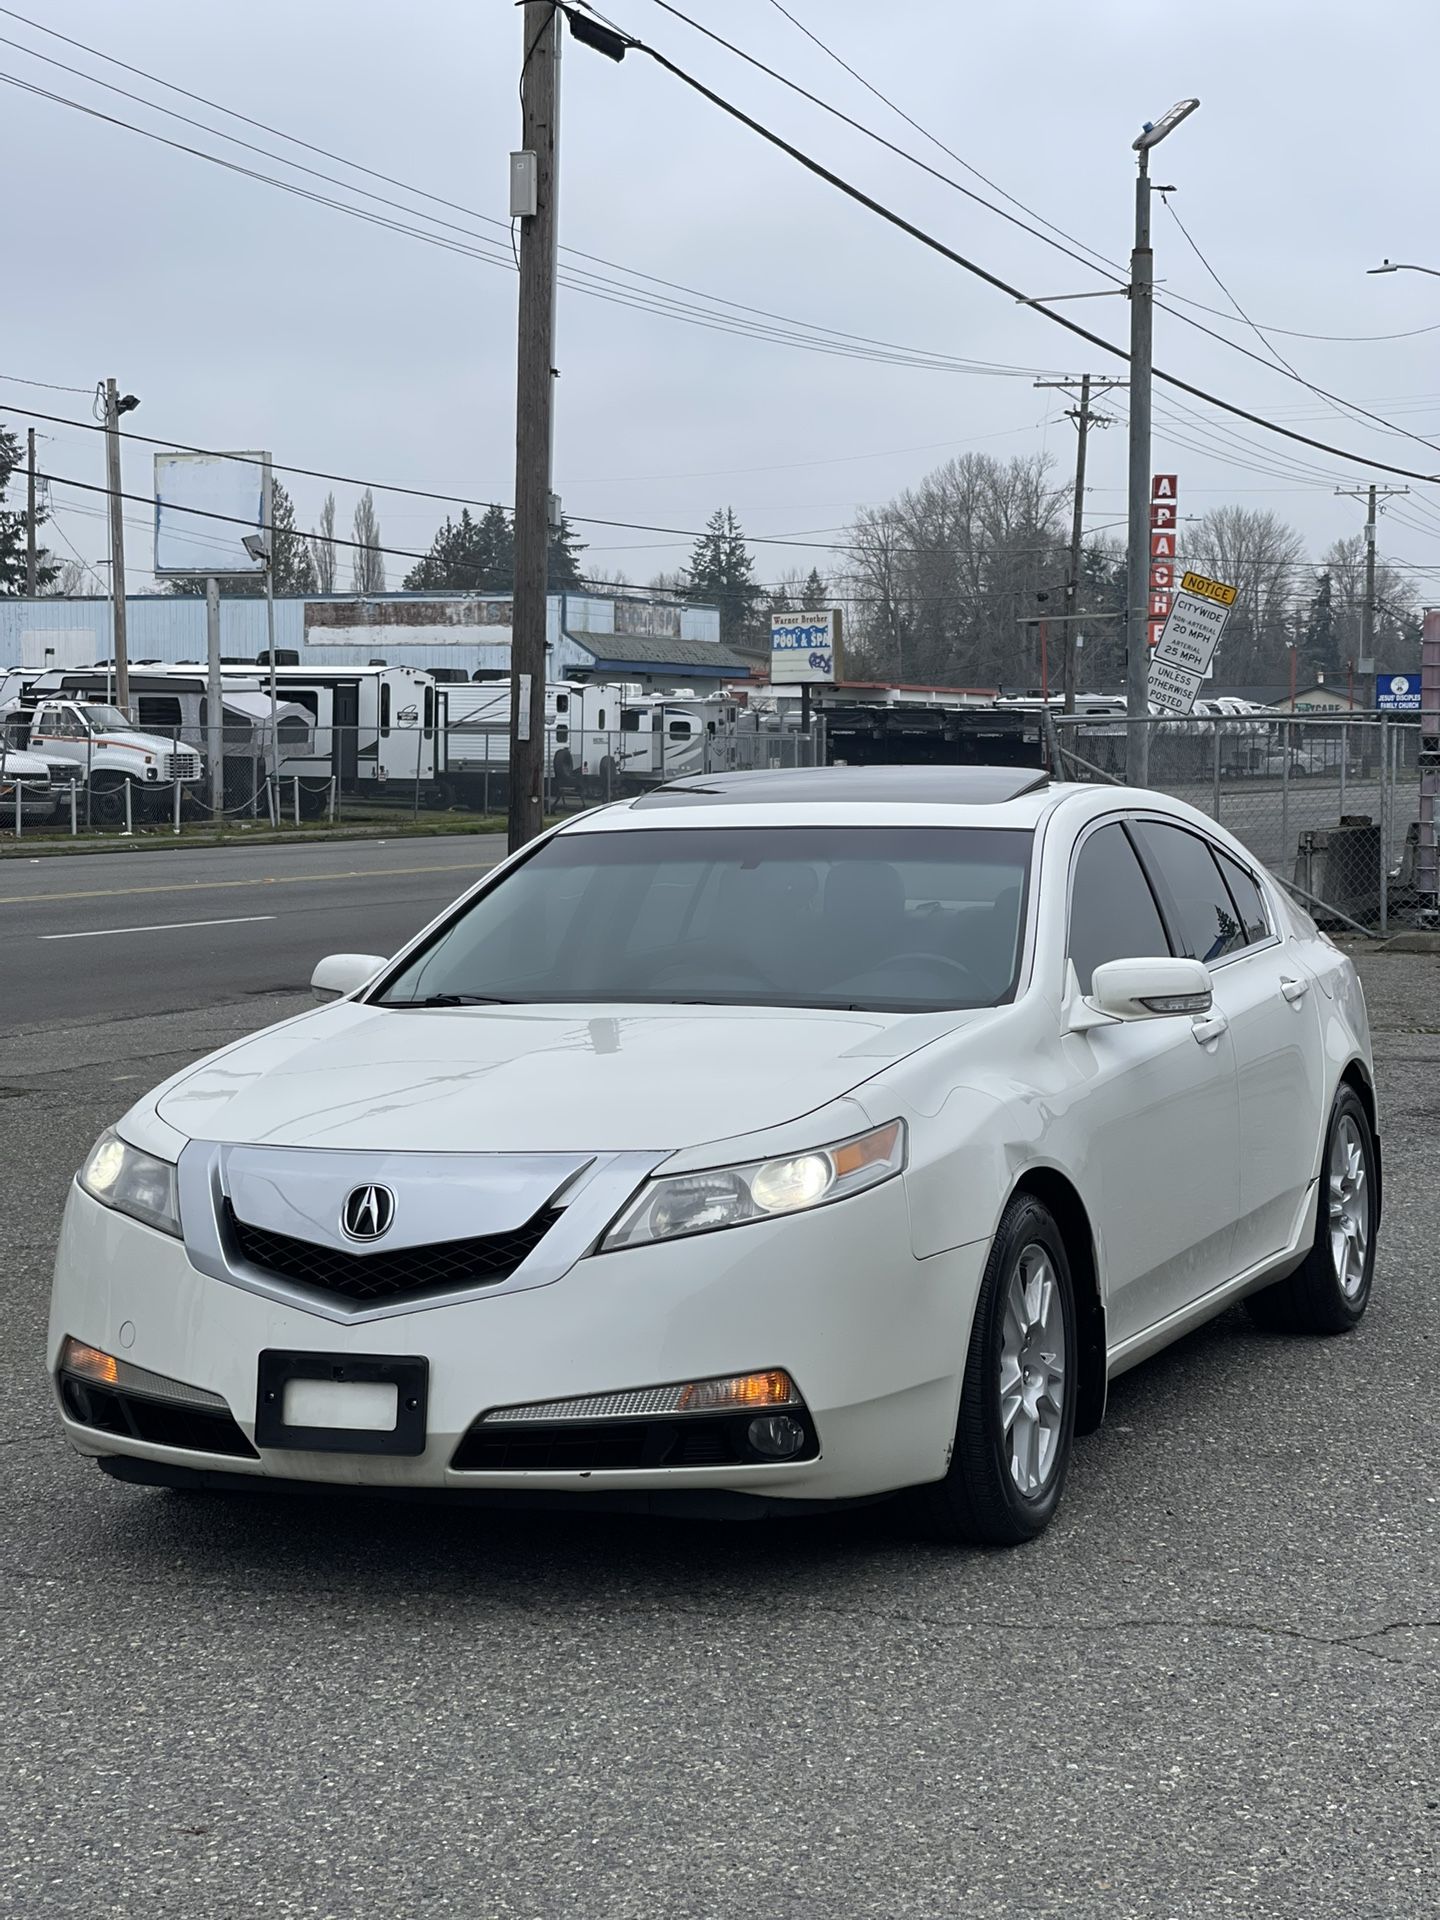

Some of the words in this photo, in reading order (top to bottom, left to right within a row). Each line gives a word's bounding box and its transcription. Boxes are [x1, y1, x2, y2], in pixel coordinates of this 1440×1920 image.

[1188, 577, 1231, 600] NOTICE
[773, 616, 799, 624] Warner
[801, 614, 828, 624] Brother
[1178, 600, 1223, 623] CITYWIDE
[1173, 614, 1216, 635] NON-ARTERIAL
[1173, 623, 1187, 635] 20
[1188, 629, 1211, 643] MPH
[773, 633, 798, 648] POOL
[800, 633, 808, 647] &
[810, 632, 829, 647] SPA
[1171, 639, 1201, 654] ARTERIAL
[1164, 645, 1178, 656] 25
[1180, 650, 1202, 665] MPH
[1158, 667, 1192, 686] UNLESS
[1148, 676, 1194, 699] OTHERWISE
[1150, 690, 1183, 708] POSTED
